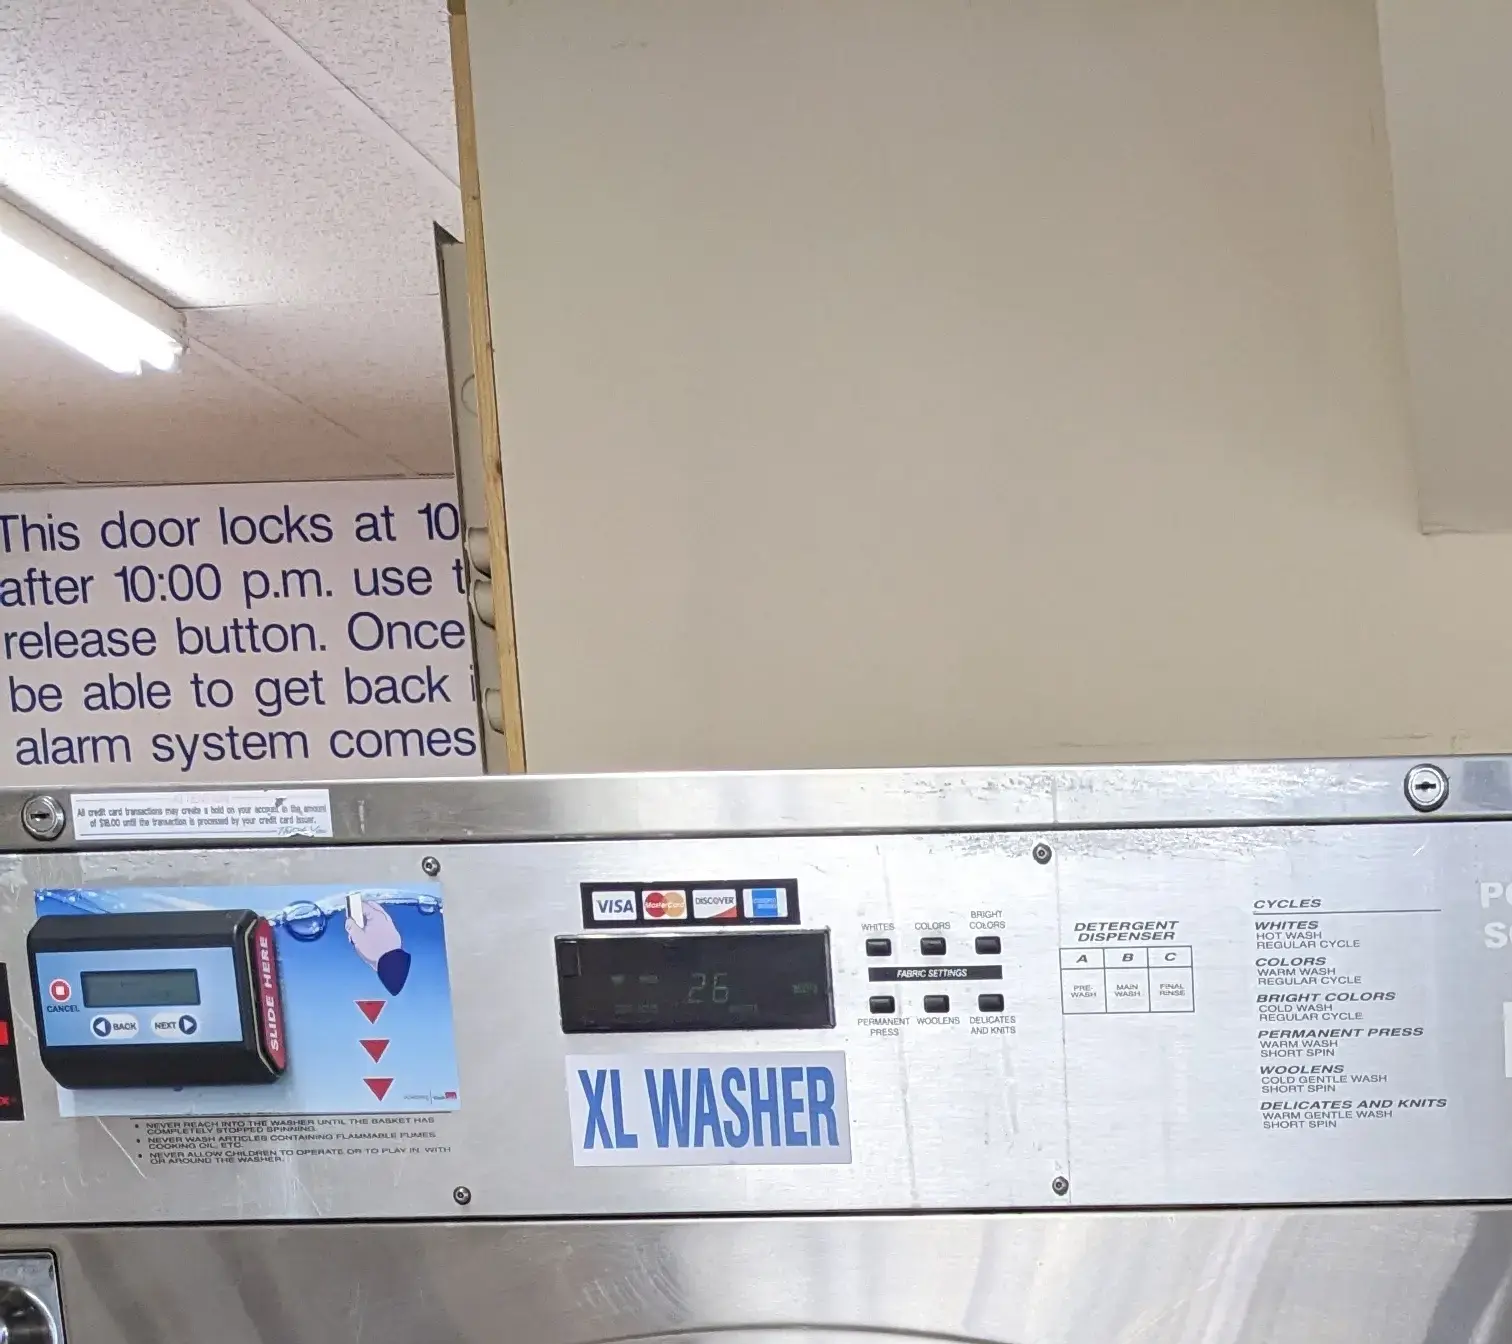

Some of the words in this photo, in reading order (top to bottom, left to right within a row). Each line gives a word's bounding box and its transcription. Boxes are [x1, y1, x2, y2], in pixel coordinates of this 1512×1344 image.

[0, 513, 81, 553] This
[101, 510, 200, 549] door
[219, 505, 334, 545] locks
[355, 505, 397, 542] at
[417, 503, 460, 540] 10
[0, 568, 94, 606] after
[114, 563, 221, 602] 10:00
[243, 568, 333, 609] p.m.
[354, 566, 432, 597] use
[4, 621, 157, 660] release
[176, 617, 327, 654] button.
[348, 611, 466, 651] Once
[9, 675, 62, 713] be
[84, 672, 171, 711] able
[190, 673, 233, 708] to
[255, 670, 325, 717] get
[345, 665, 451, 705] back
[16, 728, 131, 766] alarm
[152, 726, 309, 773] system
[330, 727, 477, 759] comes
[695, 896, 735, 906] DISCOVER
[1253, 899, 1321, 909] CYCLES
[597, 899, 634, 914] VISA
[970, 910, 1002, 919] BRIGHT
[861, 923, 895, 931] WHITES
[914, 922, 951, 930] COLORS
[969, 921, 1006, 930] COLORS
[1074, 921, 1179, 931] DETERGENT
[1255, 921, 1319, 930] WHITES
[1078, 932, 1175, 942] DISPENSER
[1256, 932, 1282, 940] HOT
[1285, 931, 1322, 940] WASH
[1256, 941, 1316, 949] REGULAR
[1320, 940, 1360, 948] CYCLE
[1076, 954, 1088, 963] A
[1122, 953, 1134, 962] B
[1164, 952, 1177, 961] C
[259, 935, 273, 989] HERE
[1255, 957, 1327, 967] COLORS
[897, 969, 926, 978] FABRIC
[927, 968, 967, 978] SETTINGS
[1257, 968, 1296, 976] WARM
[1299, 967, 1336, 976] WASH
[1258, 977, 1317, 985] REGULAR
[1320, 976, 1362, 984] CYCLE
[1256, 993, 1321, 1003] BRIGHT
[1324, 992, 1396, 1001] COLORS
[46, 1005, 80, 1013] CANCEL
[1258, 1004, 1293, 1013] COLD
[1296, 1004, 1333, 1012] WASH
[858, 1017, 910, 1026] PERMANENT
[916, 1017, 960, 1025] WOOLENS
[969, 1016, 1016, 1024] DELICATES
[1259, 1013, 1318, 1022] REGULAR
[1322, 1012, 1363, 1020] CYCLE
[113, 1022, 137, 1031] BACK
[154, 1021, 177, 1030] NEXT
[266, 995, 280, 1052] SLIDE
[870, 1028, 899, 1036] PRESS
[970, 1026, 989, 1035] AND
[990, 1026, 1016, 1034] KNITS
[1258, 1029, 1364, 1039] PERMANENT
[1367, 1027, 1424, 1037] PRESS
[1260, 1040, 1298, 1048] WARM
[1301, 1040, 1338, 1048] WASH
[1260, 1049, 1303, 1057] SHORT
[1306, 1049, 1335, 1057] SPIN
[1260, 1065, 1344, 1075] WOOLENS
[1261, 1076, 1295, 1085] COLD
[1299, 1075, 1347, 1084] GENTLE
[1350, 1075, 1388, 1083] WASH
[1261, 1085, 1304, 1093] SHORT
[1307, 1084, 1336, 1092] SPIN
[577, 1069, 638, 1149] XL
[644, 1066, 840, 1148] WASHER
[1260, 1100, 1352, 1110] DELICATES
[1357, 1099, 1393, 1109] AND
[1397, 1099, 1447, 1108] KNITS
[1262, 1112, 1300, 1120] WARM
[1304, 1111, 1353, 1119] GENTLE
[1356, 1110, 1393, 1118] WASH
[1263, 1121, 1306, 1129] SHORT
[1308, 1120, 1337, 1128] SPIN
